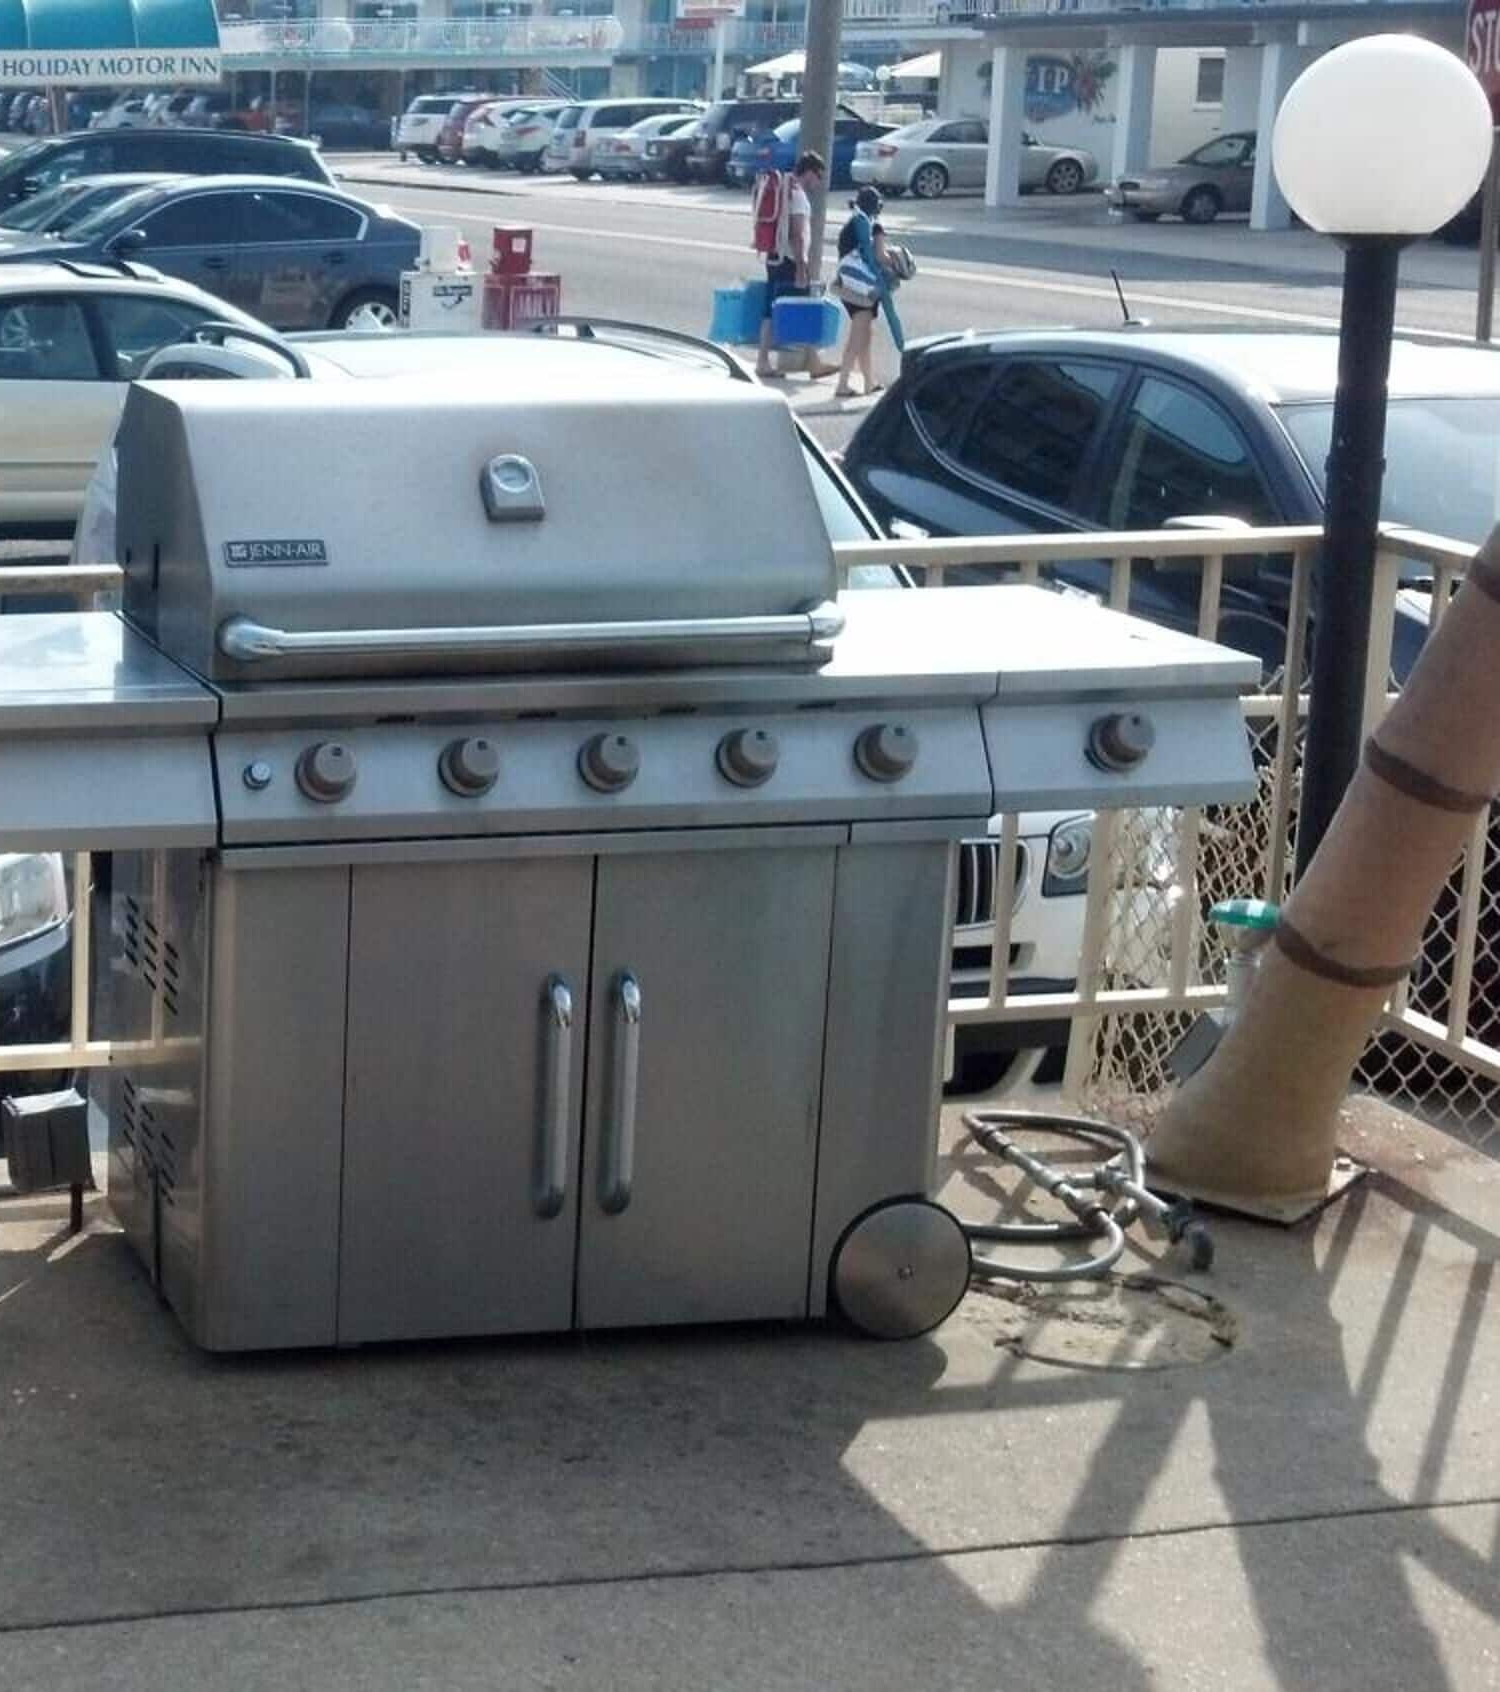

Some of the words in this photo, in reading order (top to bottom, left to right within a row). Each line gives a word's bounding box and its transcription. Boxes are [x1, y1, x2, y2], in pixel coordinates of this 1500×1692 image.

[2, 57, 93, 77] HOLIDAY
[99, 56, 175, 76] MOTOR
[181, 55, 218, 75] INN
[249, 542, 323, 561] JENN-AIR
